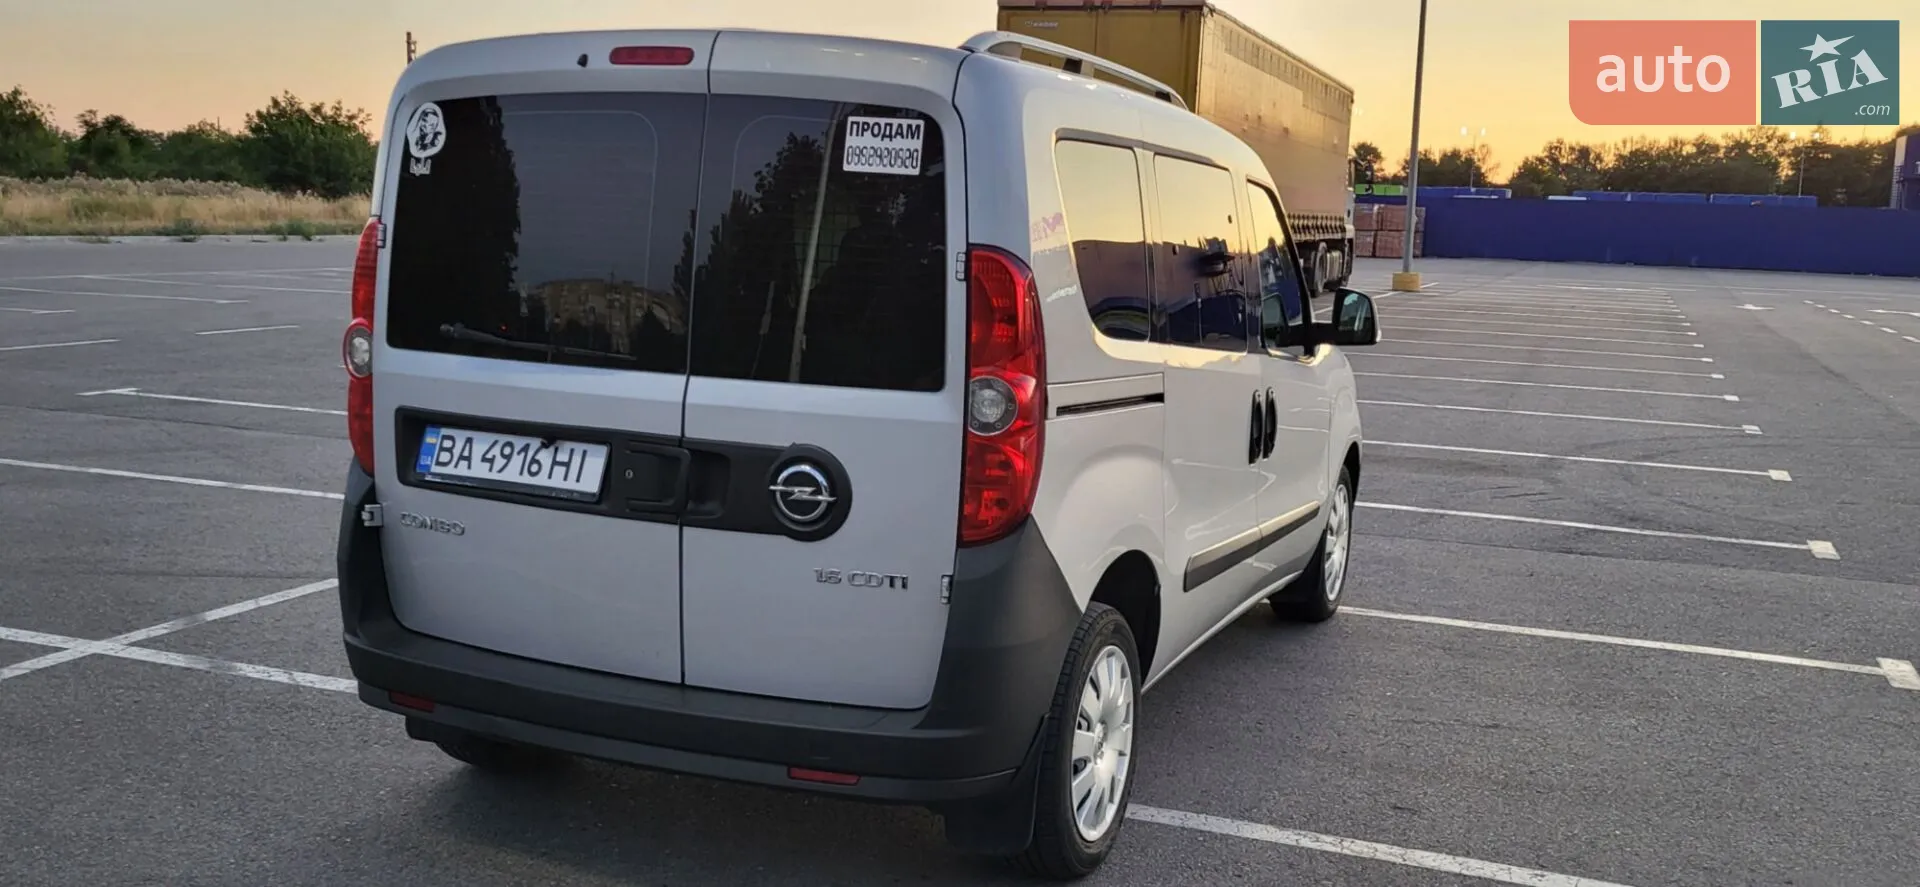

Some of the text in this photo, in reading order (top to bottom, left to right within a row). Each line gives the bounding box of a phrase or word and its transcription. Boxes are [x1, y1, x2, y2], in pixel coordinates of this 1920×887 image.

[849, 120, 921, 142] ПРОДАМ
[434, 434, 588, 483] BA 4916 HI
[399, 511, 465, 537] COMBO
[847, 570, 909, 590] CDTI
